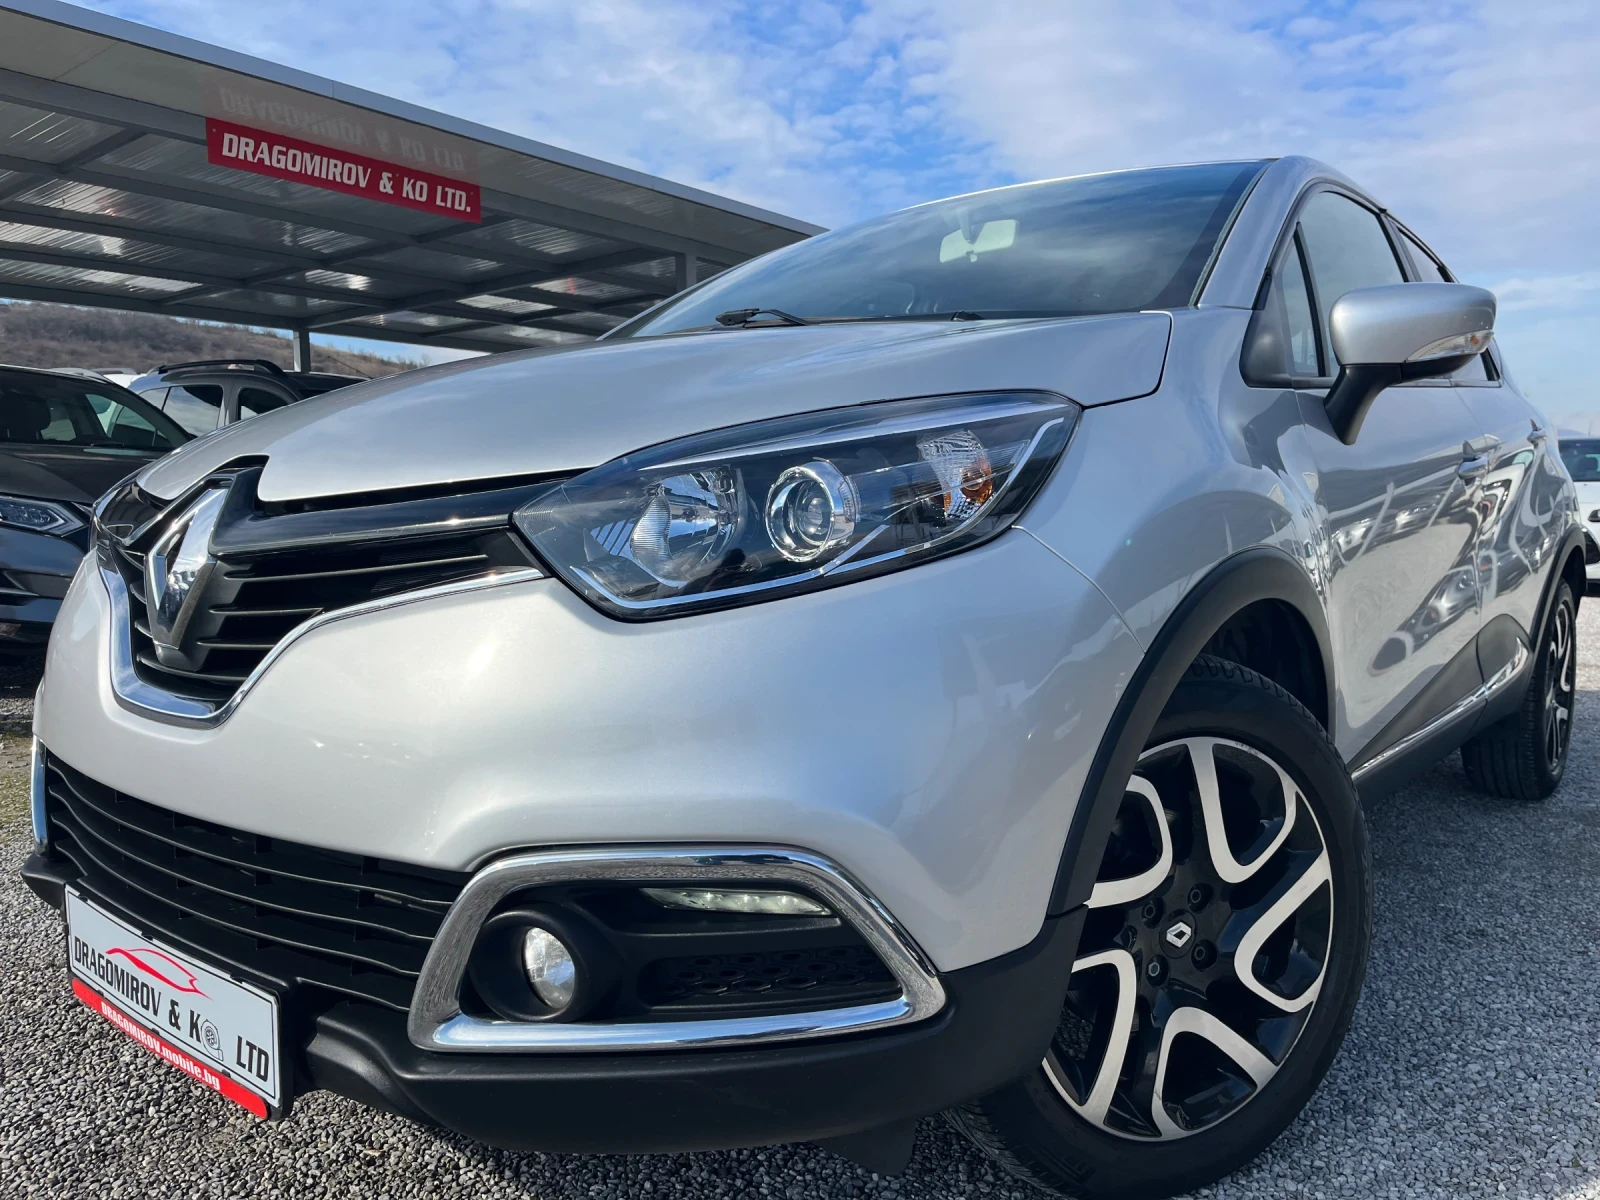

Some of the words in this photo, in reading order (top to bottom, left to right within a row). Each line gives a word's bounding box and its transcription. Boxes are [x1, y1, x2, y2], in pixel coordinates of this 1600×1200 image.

[221, 133, 371, 188] DRAGOMIROV
[379, 172, 393, 194] &
[402, 177, 427, 202] KO
[436, 186, 471, 212] LTD.
[74, 936, 162, 1017] DRAGOMIROV
[169, 999, 181, 1031] &
[236, 1035, 269, 1082] LTD
[101, 1001, 220, 1091] DRAGOMIROV.mobile.bg
